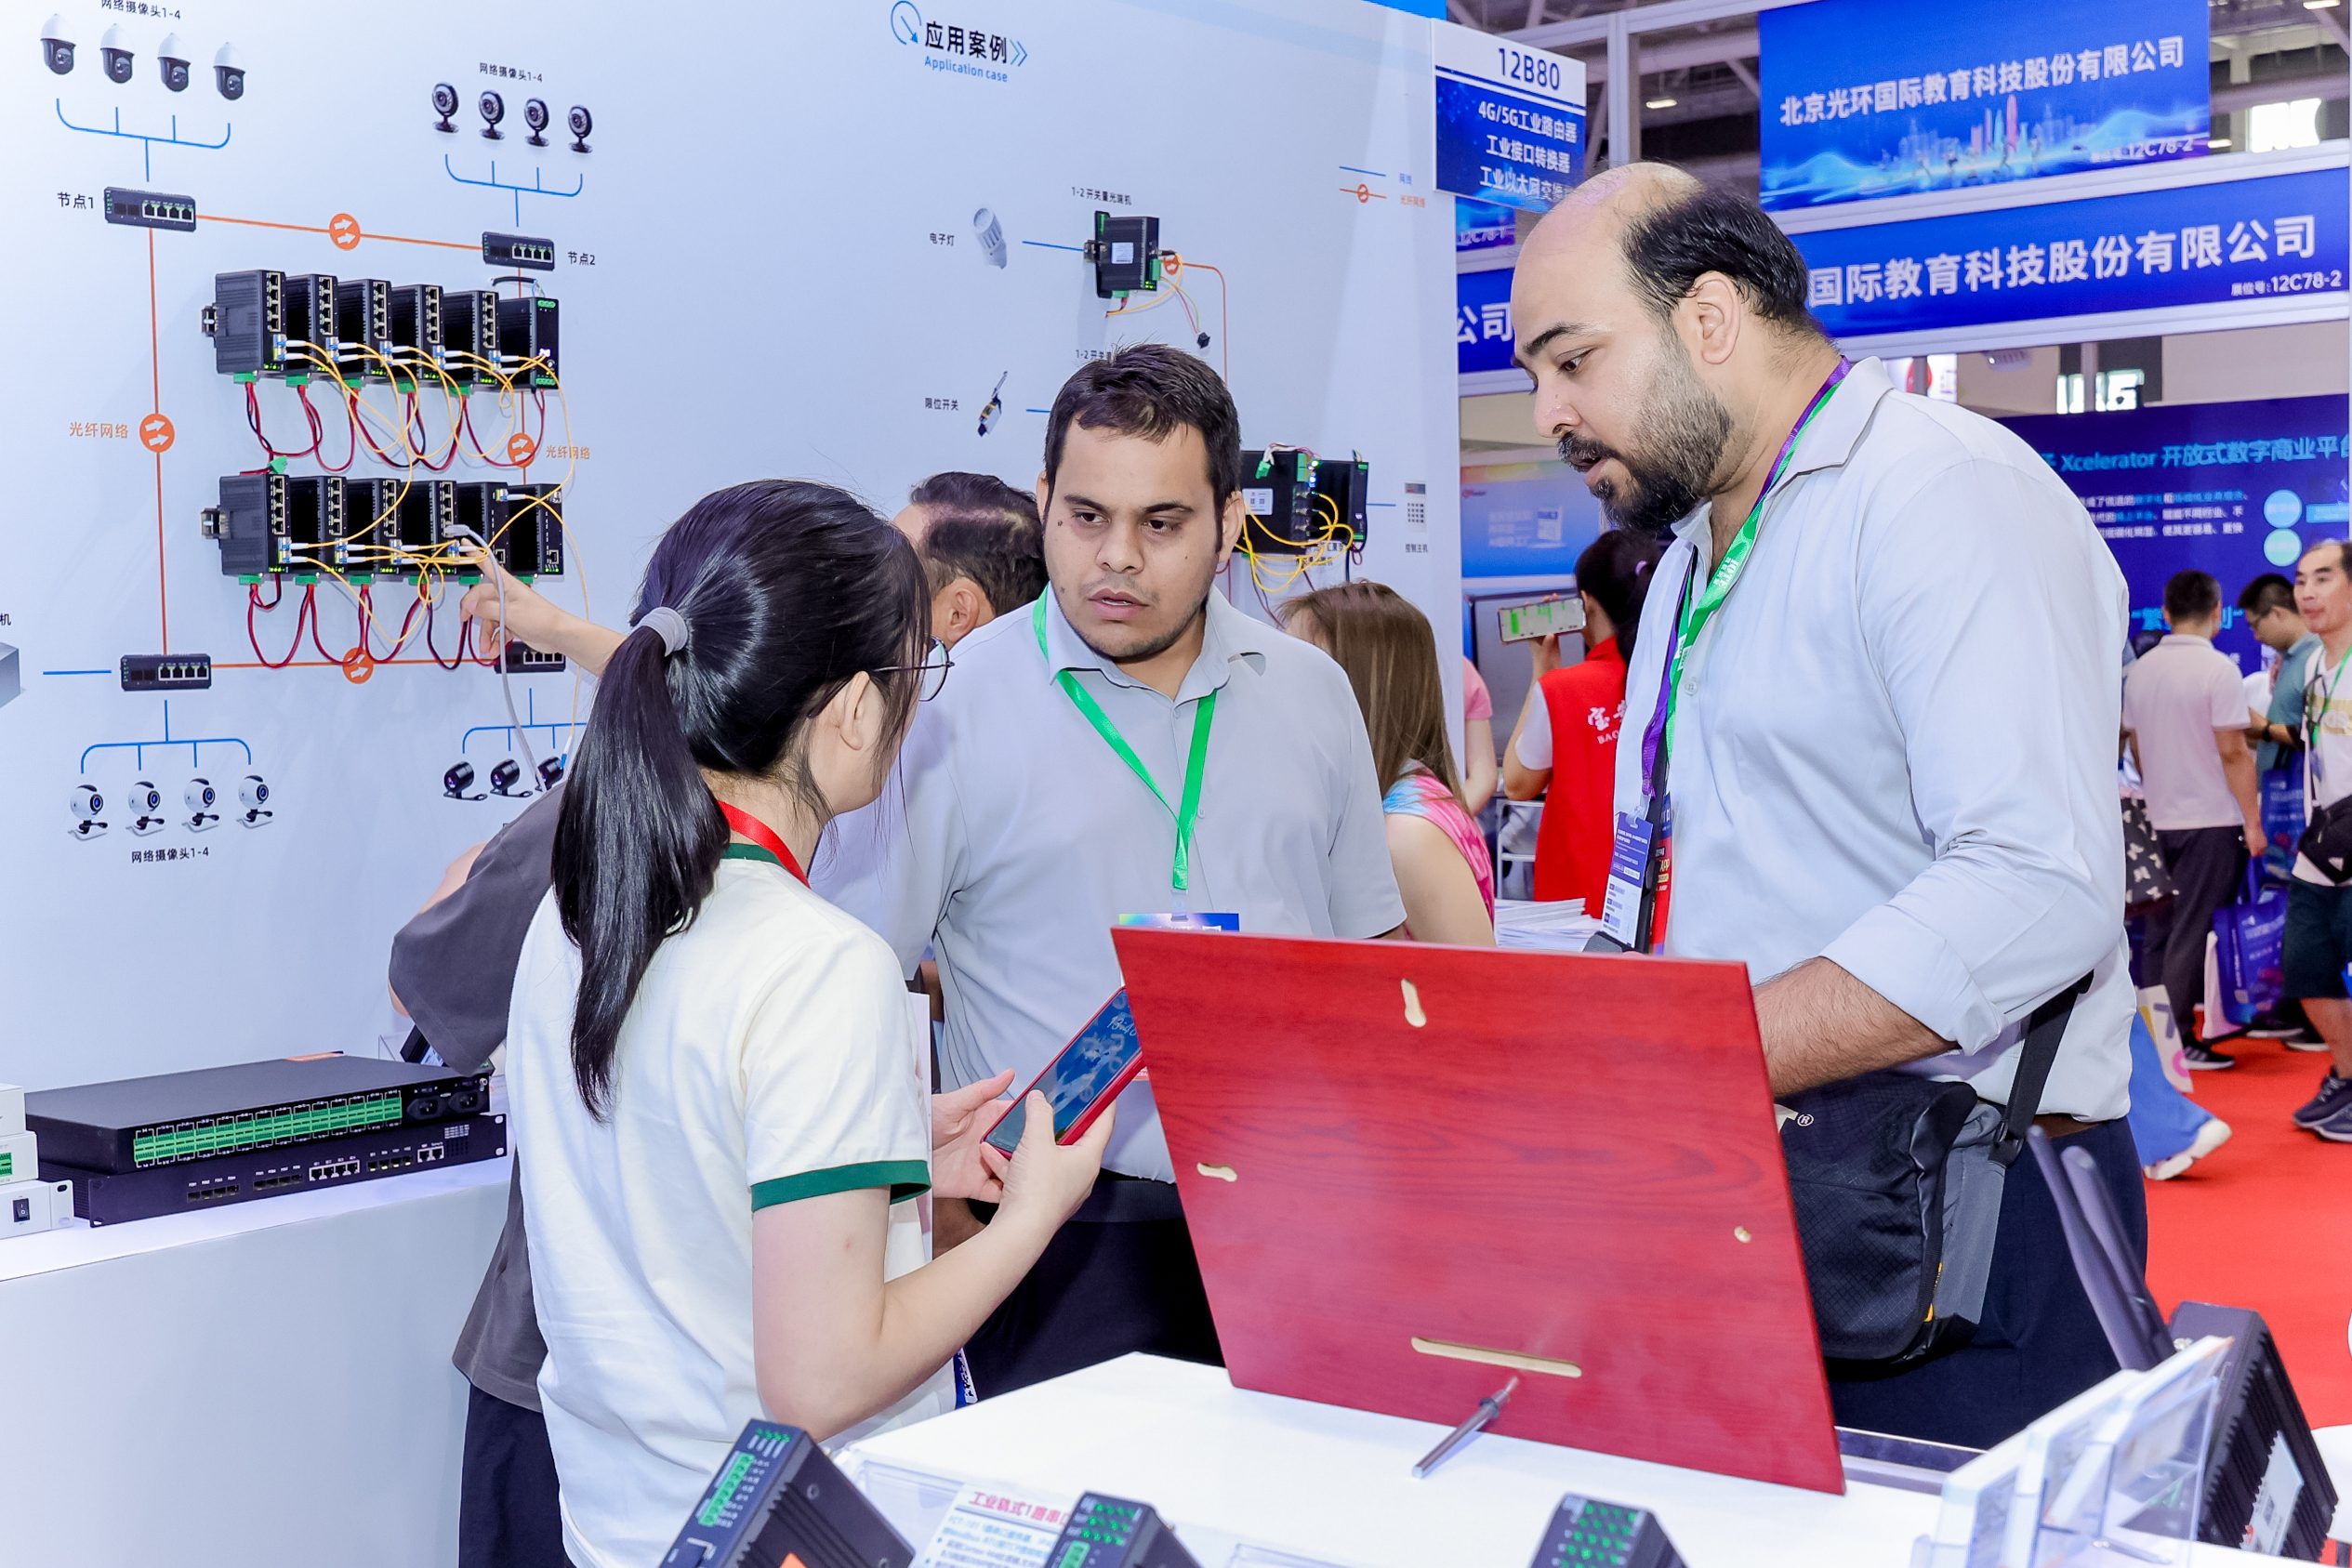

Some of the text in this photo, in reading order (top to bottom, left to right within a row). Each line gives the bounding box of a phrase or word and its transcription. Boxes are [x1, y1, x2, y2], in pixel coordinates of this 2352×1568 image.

[925, 20, 1007, 64] 应用案例
[925, 55, 1008, 83] Application case
[1498, 47, 1561, 91] 12B80
[1779, 35, 2185, 126] 北京光环国际教育科技股份有限公司
[1478, 100, 1578, 144] 4G/5G工业路由器
[1486, 134, 1570, 174] 工业接口转换器
[1479, 165, 1573, 204] 工业以太网交换
[57, 191, 94, 210] 节点1
[930, 232, 955, 246] 电子灯
[567, 251, 596, 266] 节点2
[1808, 215, 2316, 308] 国际教育科技股份有限公司
[70, 421, 128, 439] 光纤网络
[546, 445, 591, 459] 光纤网络
[2060, 451, 2158, 472] Xcelerator
[131, 844, 210, 863] 网络摄像头1-4
